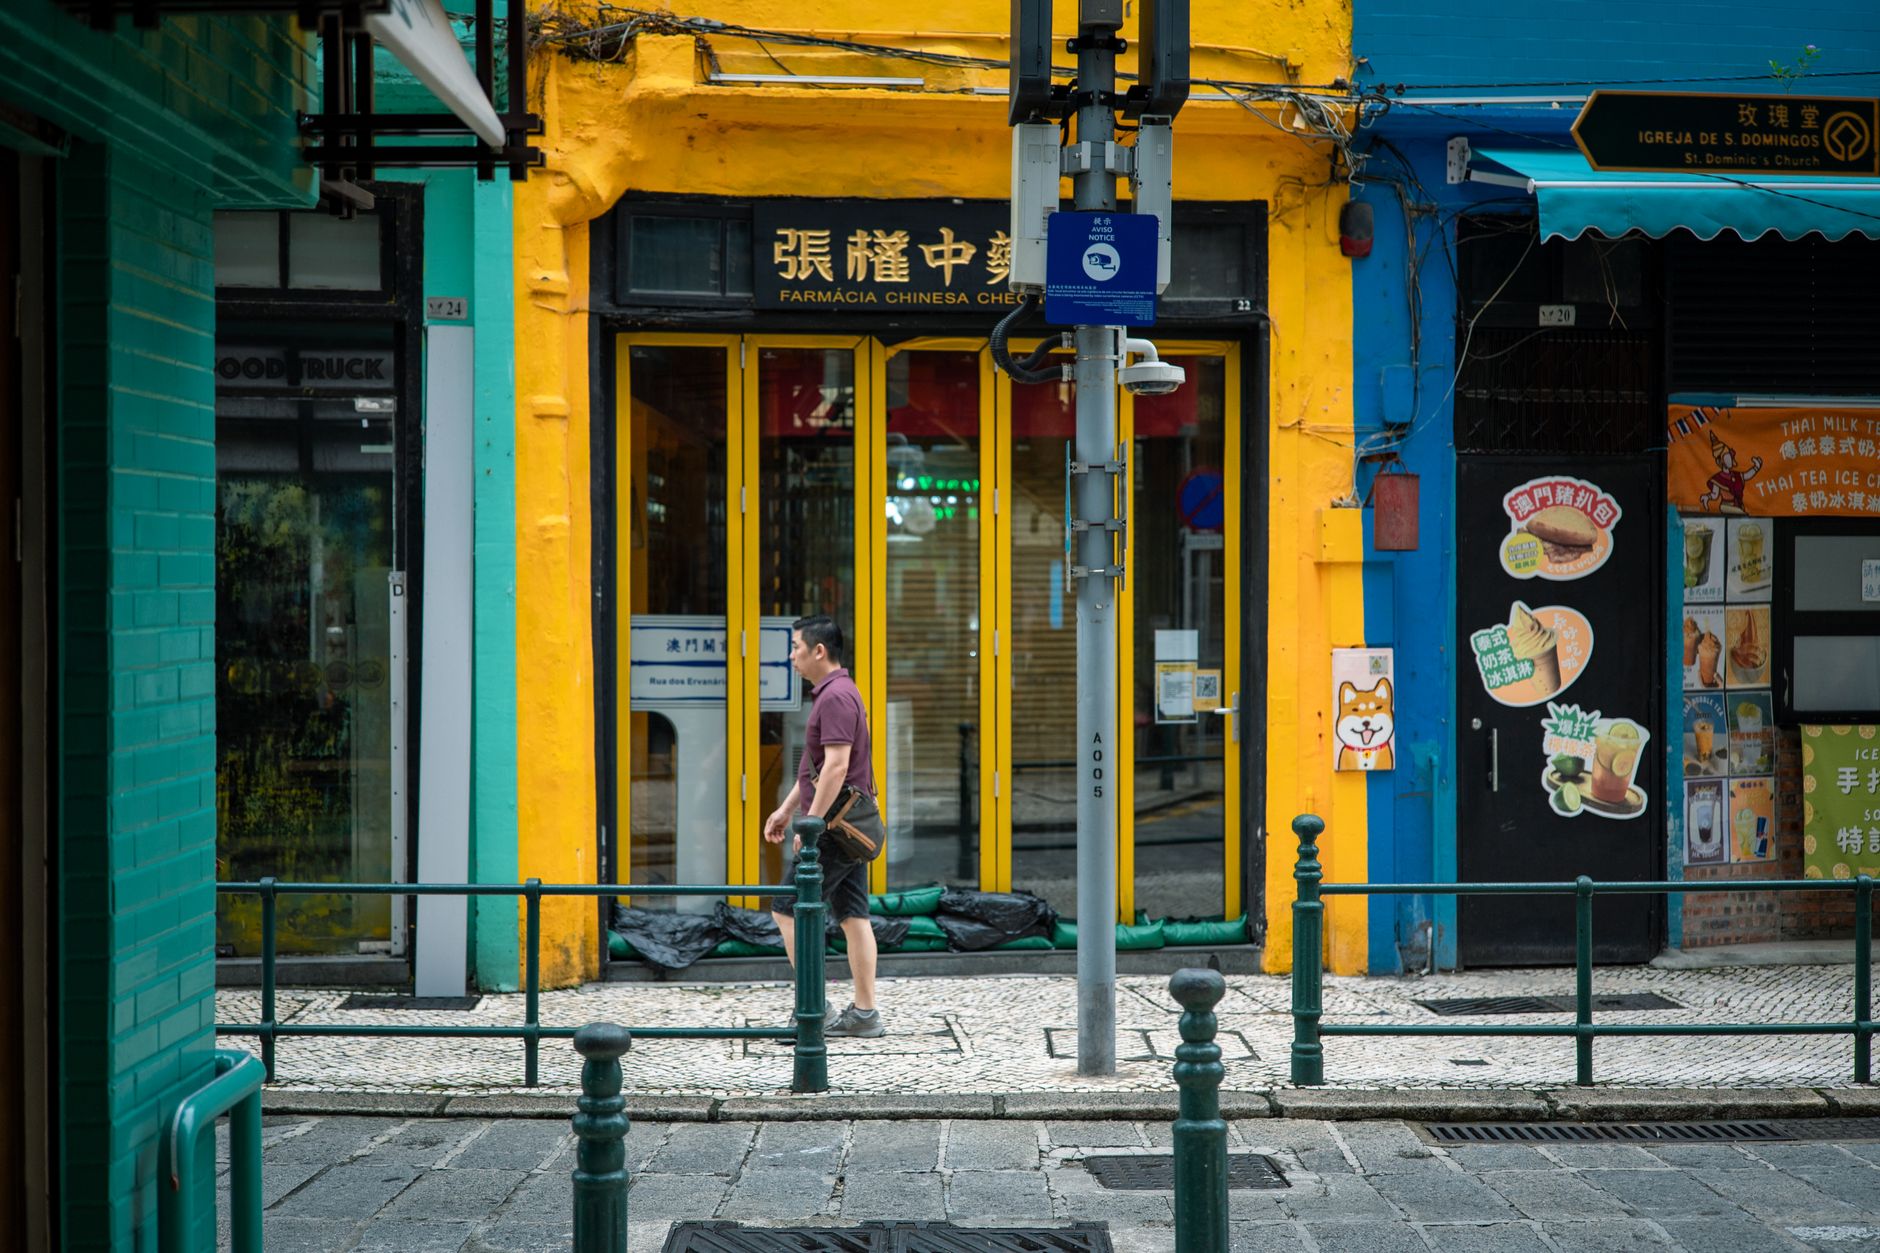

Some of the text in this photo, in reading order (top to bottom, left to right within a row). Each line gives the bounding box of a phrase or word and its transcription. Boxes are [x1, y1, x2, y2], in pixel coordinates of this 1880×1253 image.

[1738, 103, 1819, 129] 玫瑰堂
[1638, 131, 1819, 147] IGREJA DE S. DOMINGOS
[1684, 153, 1702, 164] St.
[1775, 154, 1820, 167] Church
[1093, 217, 1112, 226] 提示
[1088, 234, 1115, 242] NOTICE
[780, 287, 877, 303] FARMÁCIA
[885, 291, 970, 305] CHINESA
[446, 301, 462, 316] 24
[1237, 299, 1251, 311] 22
[1557, 308, 1570, 322] 20
[213, 356, 285, 380] OOD
[1780, 416, 1815, 437] THAI
[1823, 416, 1858, 432] MILK
[1756, 474, 1794, 497] THAI
[1799, 470, 1827, 486] TEA
[1835, 470, 1859, 486] ICE
[1481, 649, 1513, 670] 奶茶
[649, 677, 667, 685] Rua
[669, 676, 685, 685] dos
[1093, 732, 1103, 798] A005
